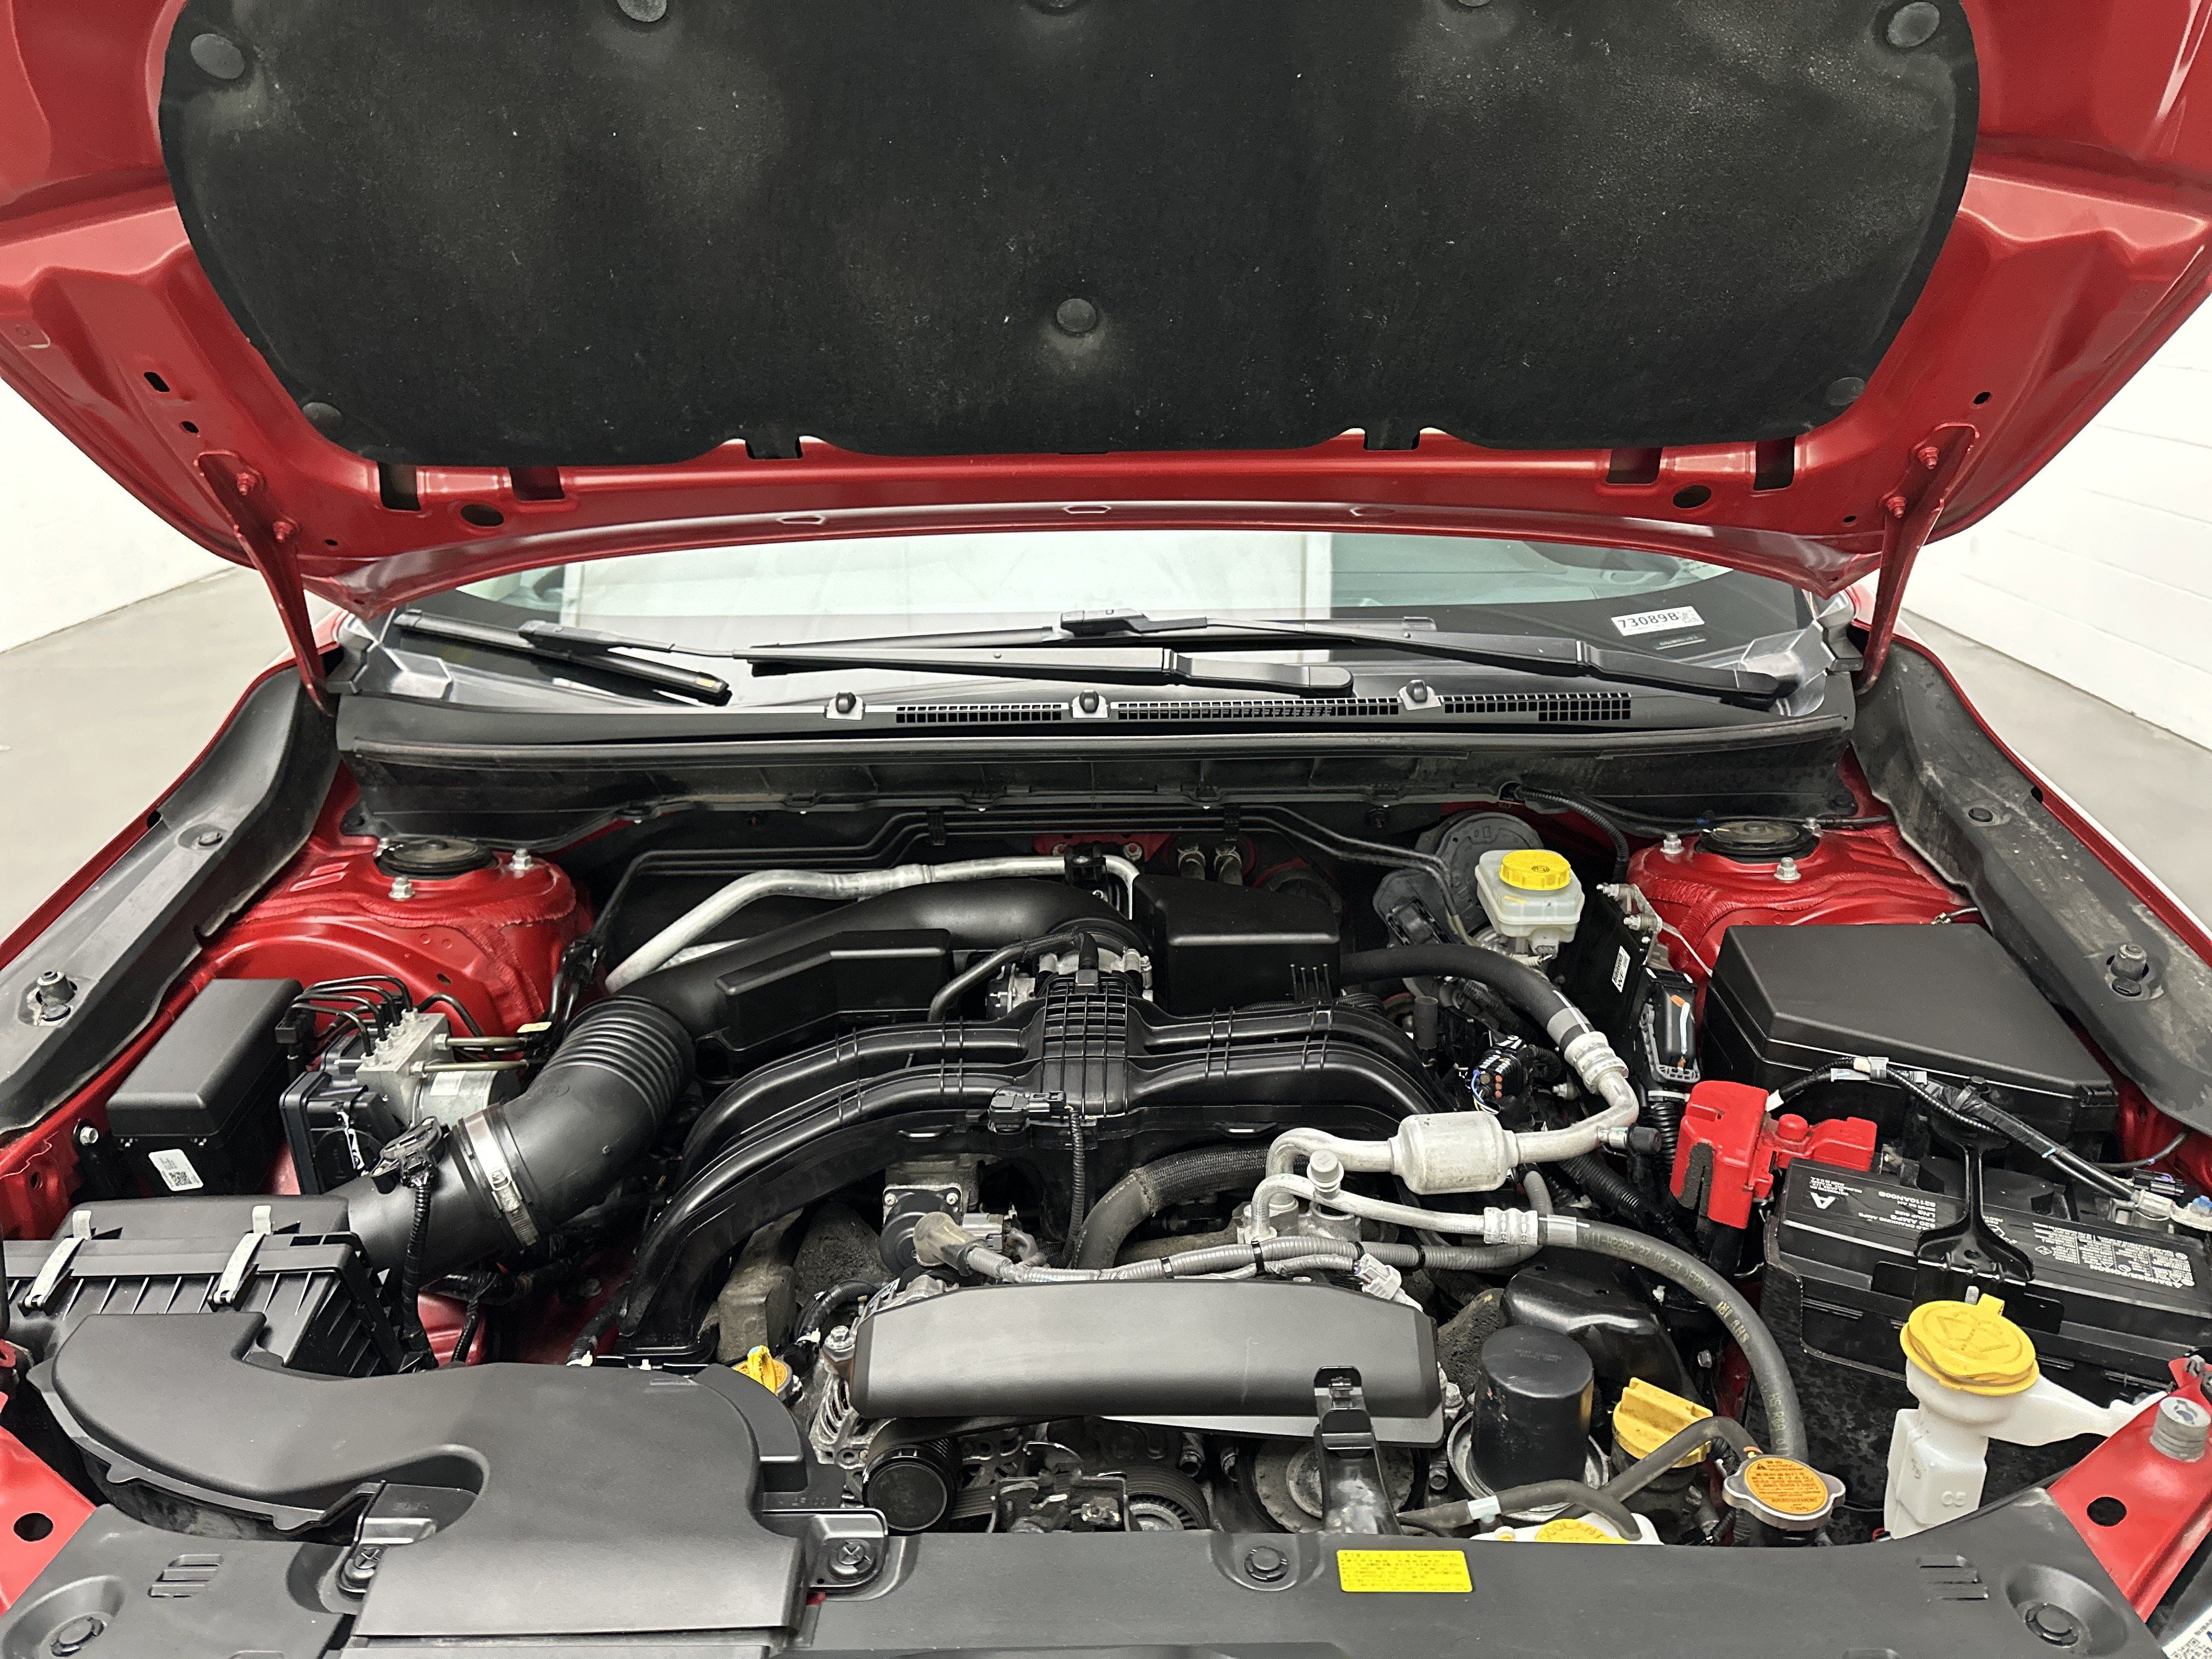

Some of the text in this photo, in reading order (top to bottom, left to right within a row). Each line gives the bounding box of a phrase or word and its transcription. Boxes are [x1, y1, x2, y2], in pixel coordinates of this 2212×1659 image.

[1858, 1212, 1878, 1220] AMPS
[1891, 1214, 1918, 1224] AMPS
[1878, 1217, 1915, 1228] CRANKING
